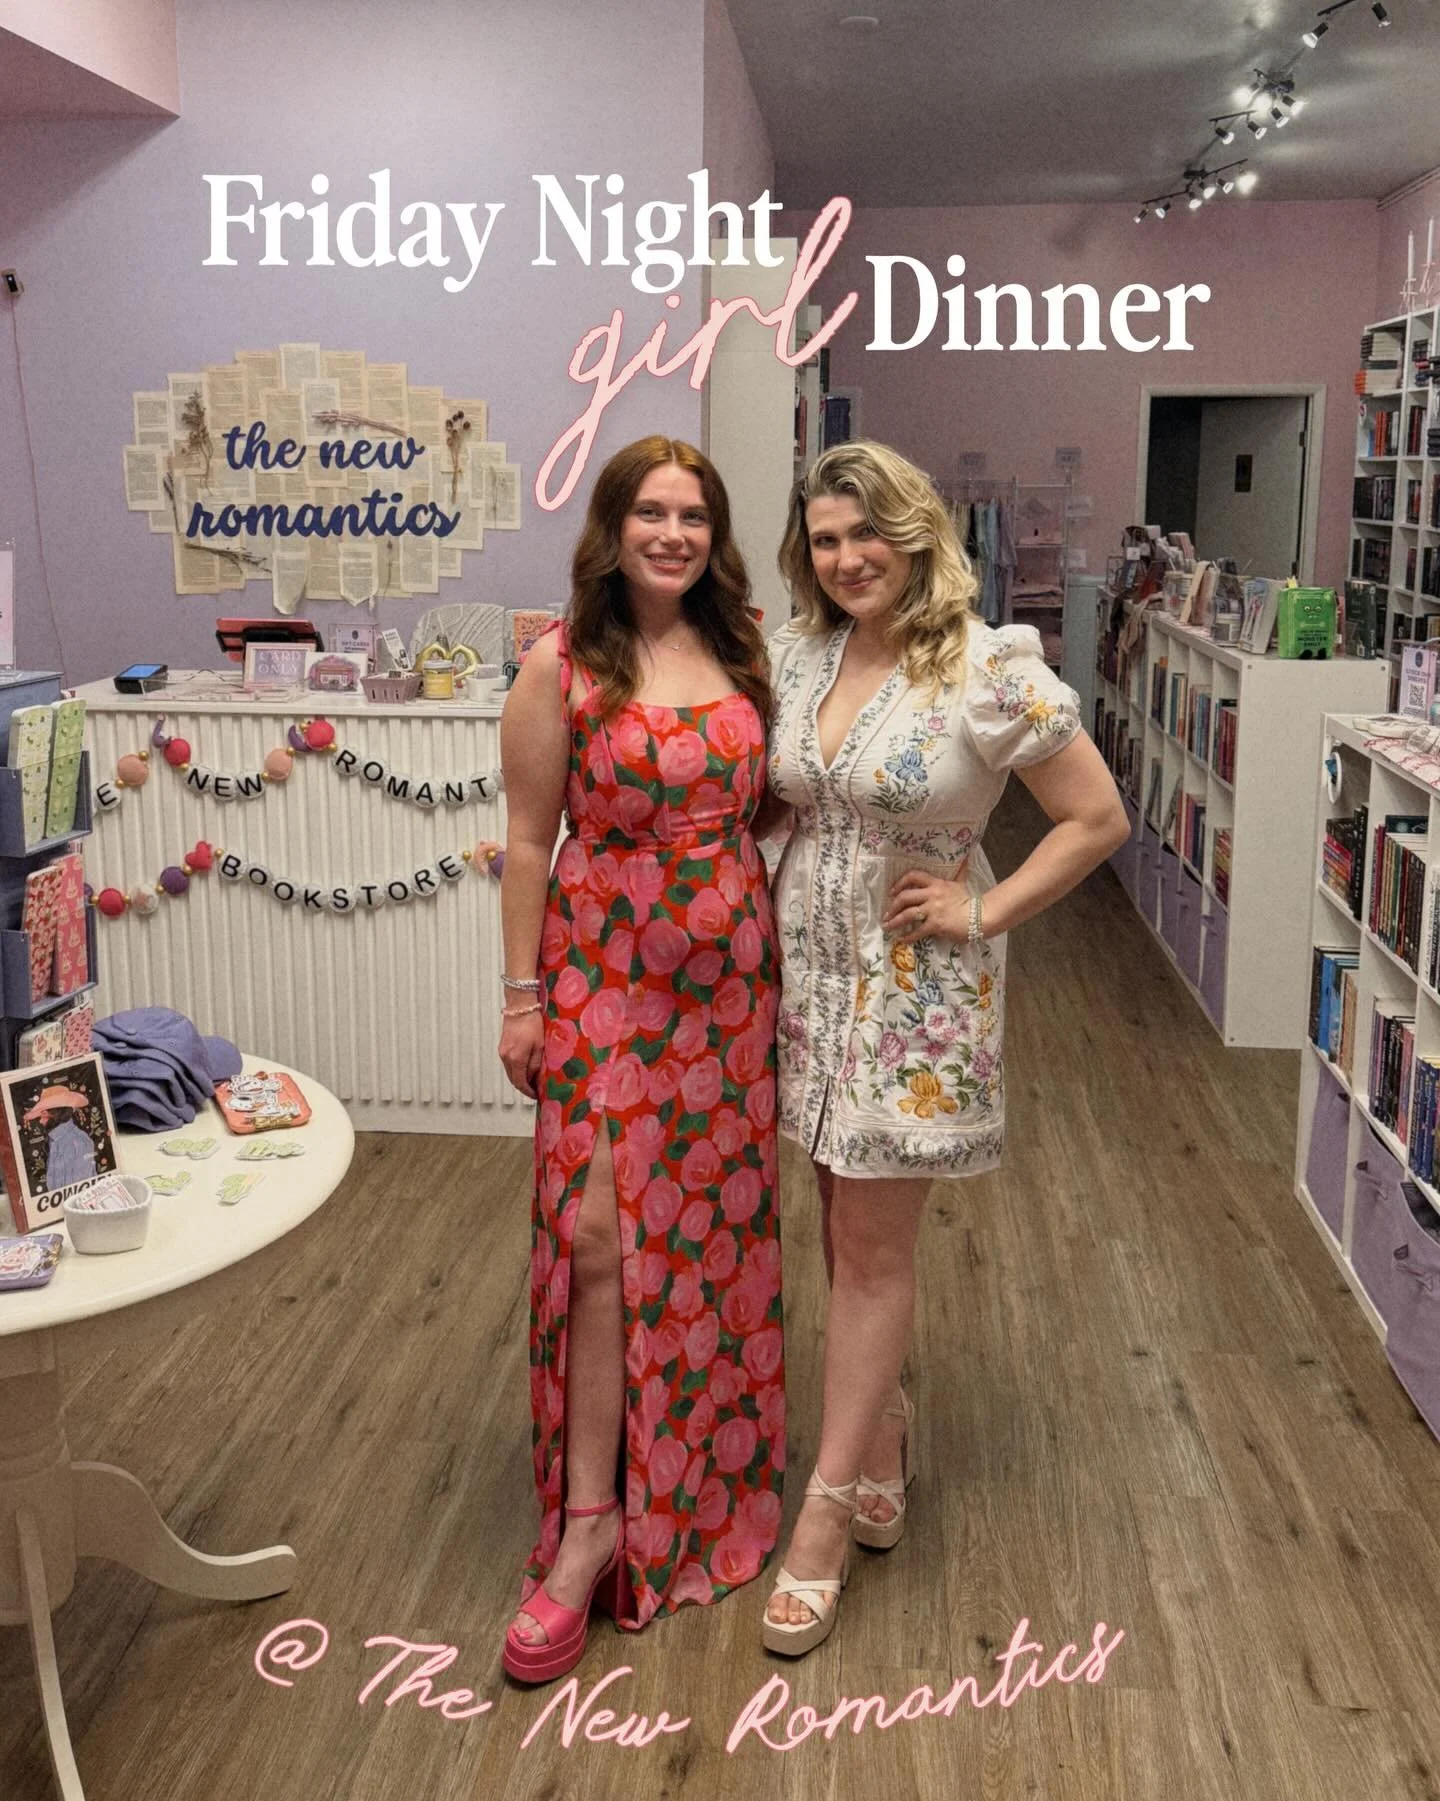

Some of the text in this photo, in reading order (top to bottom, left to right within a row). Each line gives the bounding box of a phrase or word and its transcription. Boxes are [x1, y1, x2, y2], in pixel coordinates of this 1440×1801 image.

[222, 421, 425, 470] the new
[186, 489, 461, 538] romantics
[258, 663, 300, 674] ONLY
[259, 650, 302, 662] CARD
[186, 767, 264, 798] NEW
[335, 748, 504, 805] ROMANT
[220, 854, 464, 909] BOOKSTORE
